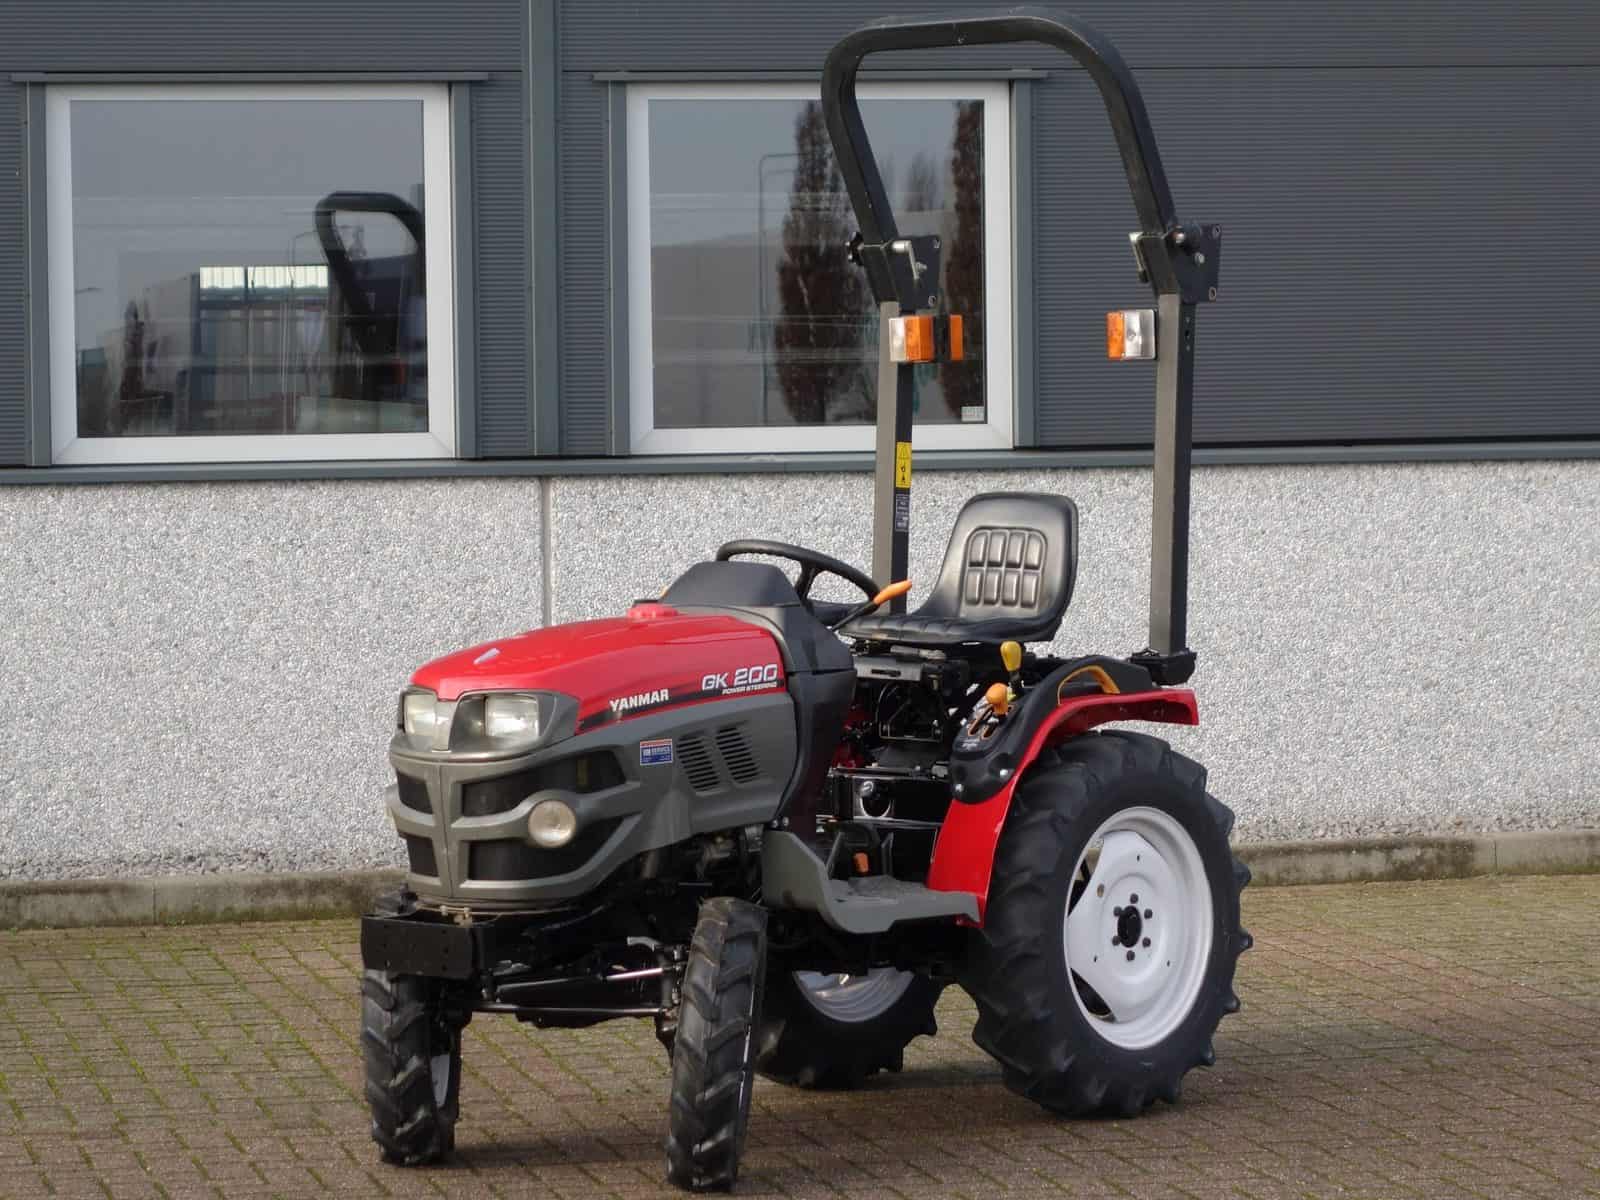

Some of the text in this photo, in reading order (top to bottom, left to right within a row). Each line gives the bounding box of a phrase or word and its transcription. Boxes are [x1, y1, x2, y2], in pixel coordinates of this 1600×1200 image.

[702, 663, 778, 690] GK 200
[609, 688, 669, 712] YANMAR
